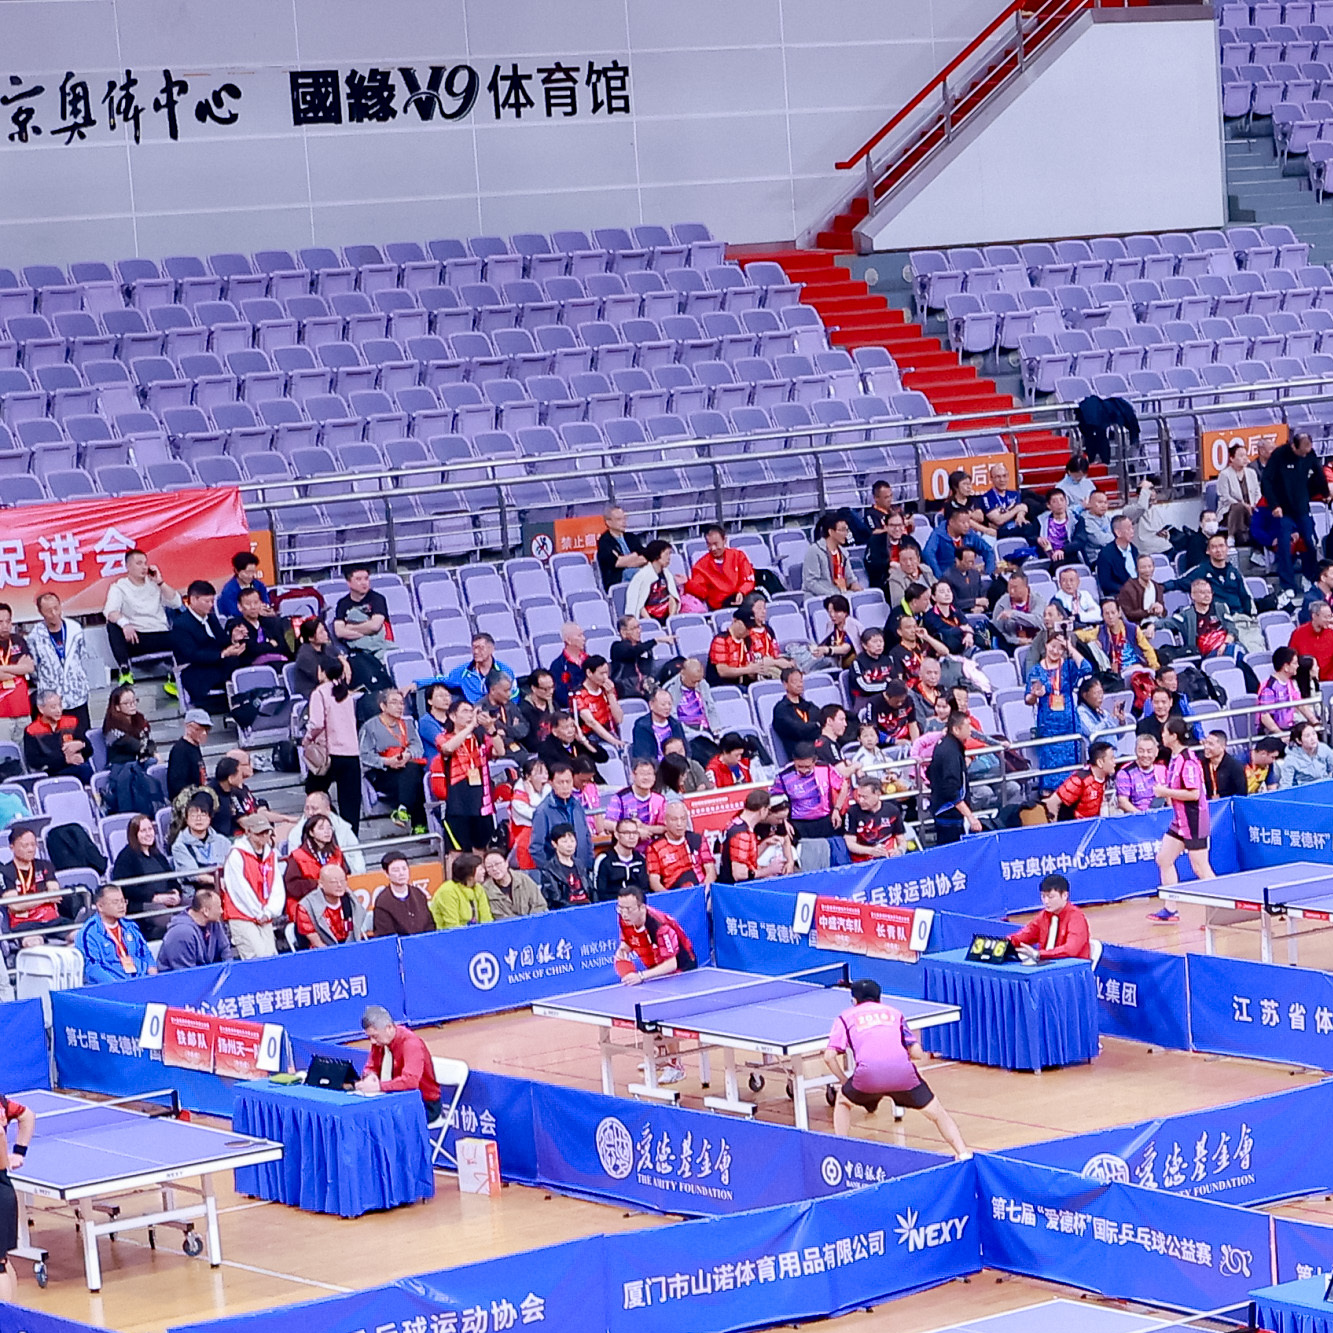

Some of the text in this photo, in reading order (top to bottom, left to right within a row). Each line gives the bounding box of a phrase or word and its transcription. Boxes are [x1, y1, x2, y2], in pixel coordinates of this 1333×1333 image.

[909, 1215, 969, 1252] NEXY
[623, 1229, 886, 1310] 厦门市山诺体育用品有限公司
